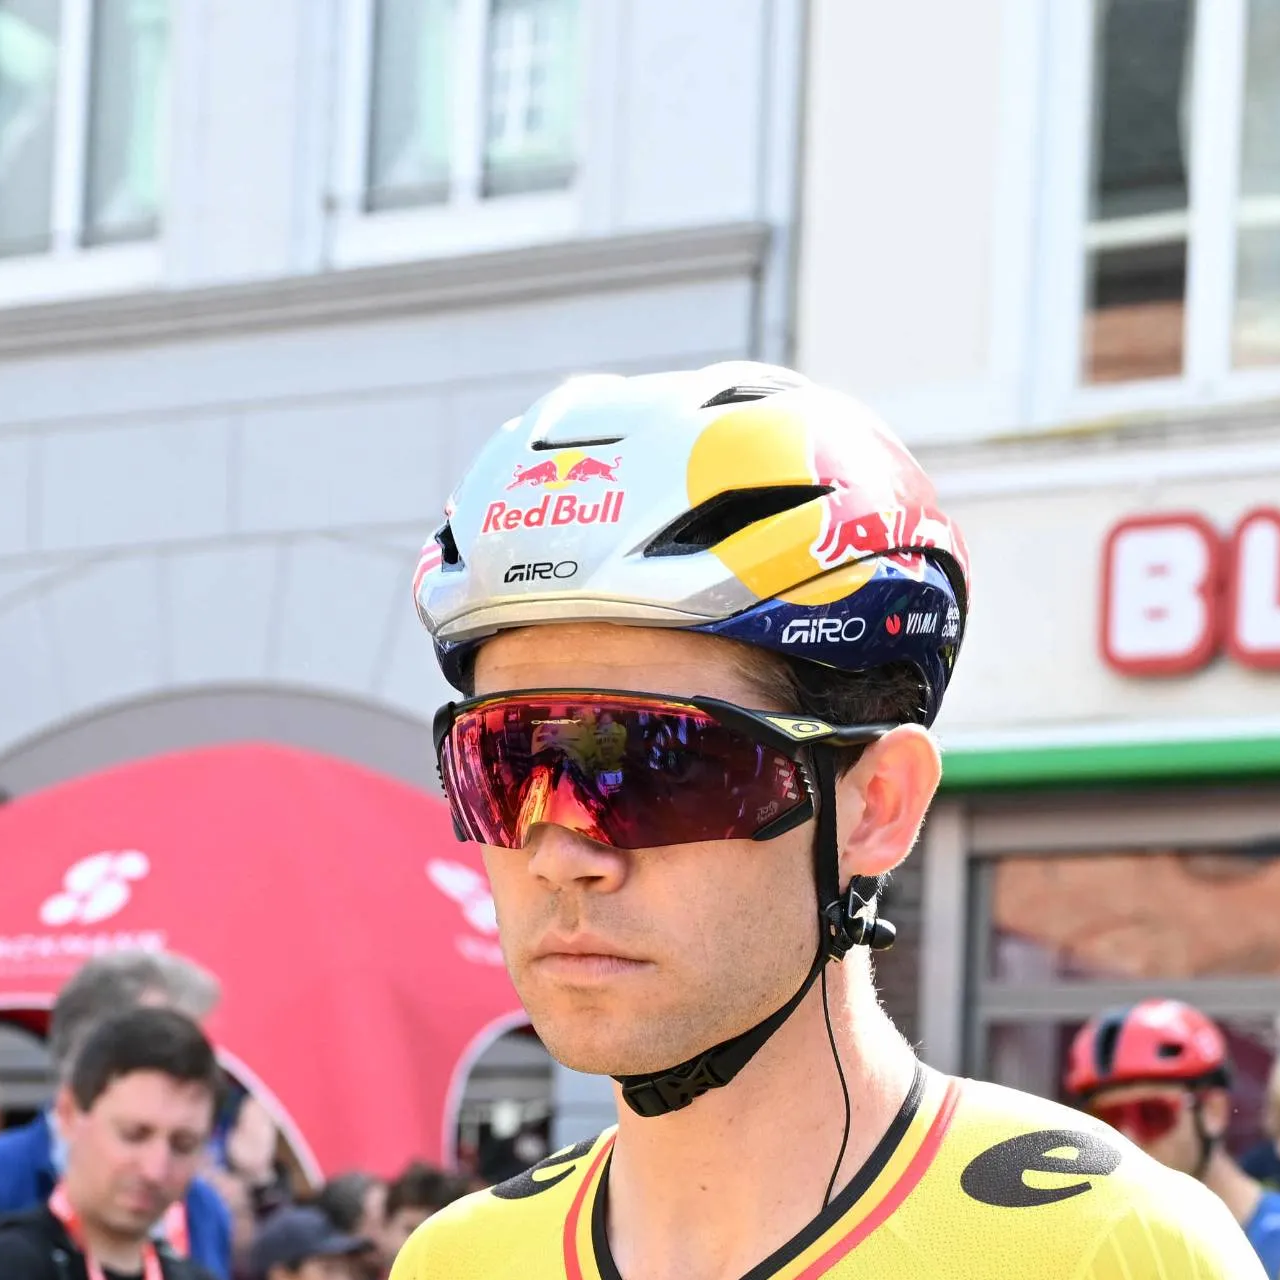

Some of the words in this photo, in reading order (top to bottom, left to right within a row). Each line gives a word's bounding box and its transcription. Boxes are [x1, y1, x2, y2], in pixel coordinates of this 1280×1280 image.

[481, 494, 552, 534] Red
[551, 491, 625, 526] Bull
[504, 560, 578, 584] GIRO
[781, 617, 866, 644] GIRO
[906, 612, 938, 635] VISMA
